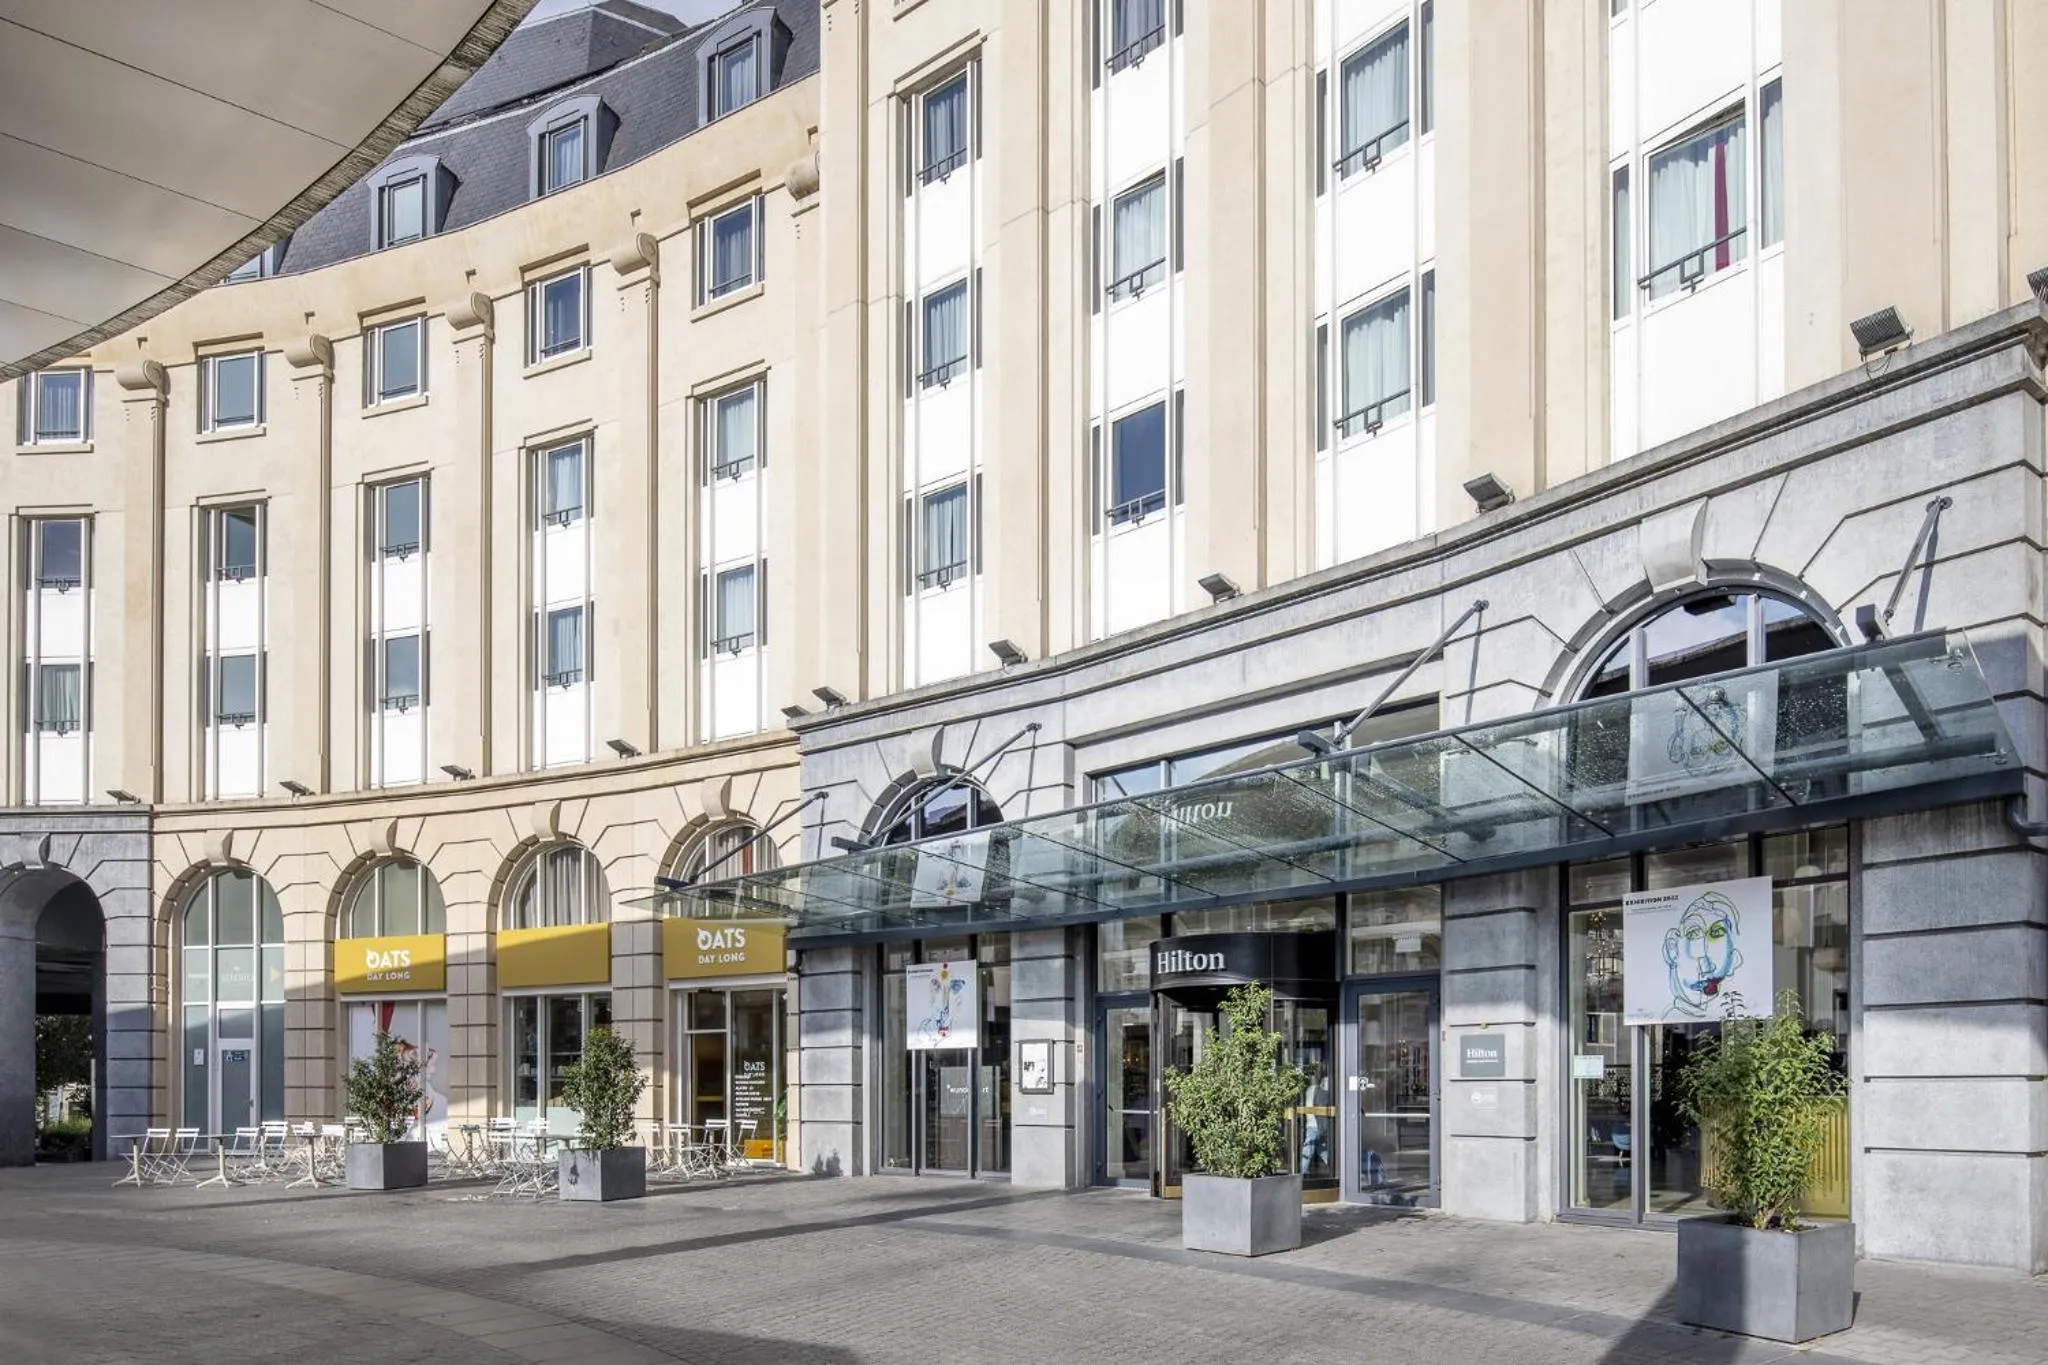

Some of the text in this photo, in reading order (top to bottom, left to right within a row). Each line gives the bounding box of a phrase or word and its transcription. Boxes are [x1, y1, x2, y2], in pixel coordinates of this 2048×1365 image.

[697, 928, 745, 950] OATS
[366, 948, 411, 968] OATS
[698, 952, 744, 964] DAY LONG
[1157, 949, 1225, 974] Hilton
[367, 971, 410, 981] DAY LONG
[1466, 1047, 1498, 1058] Hilton
[744, 1060, 765, 1071] OATS
